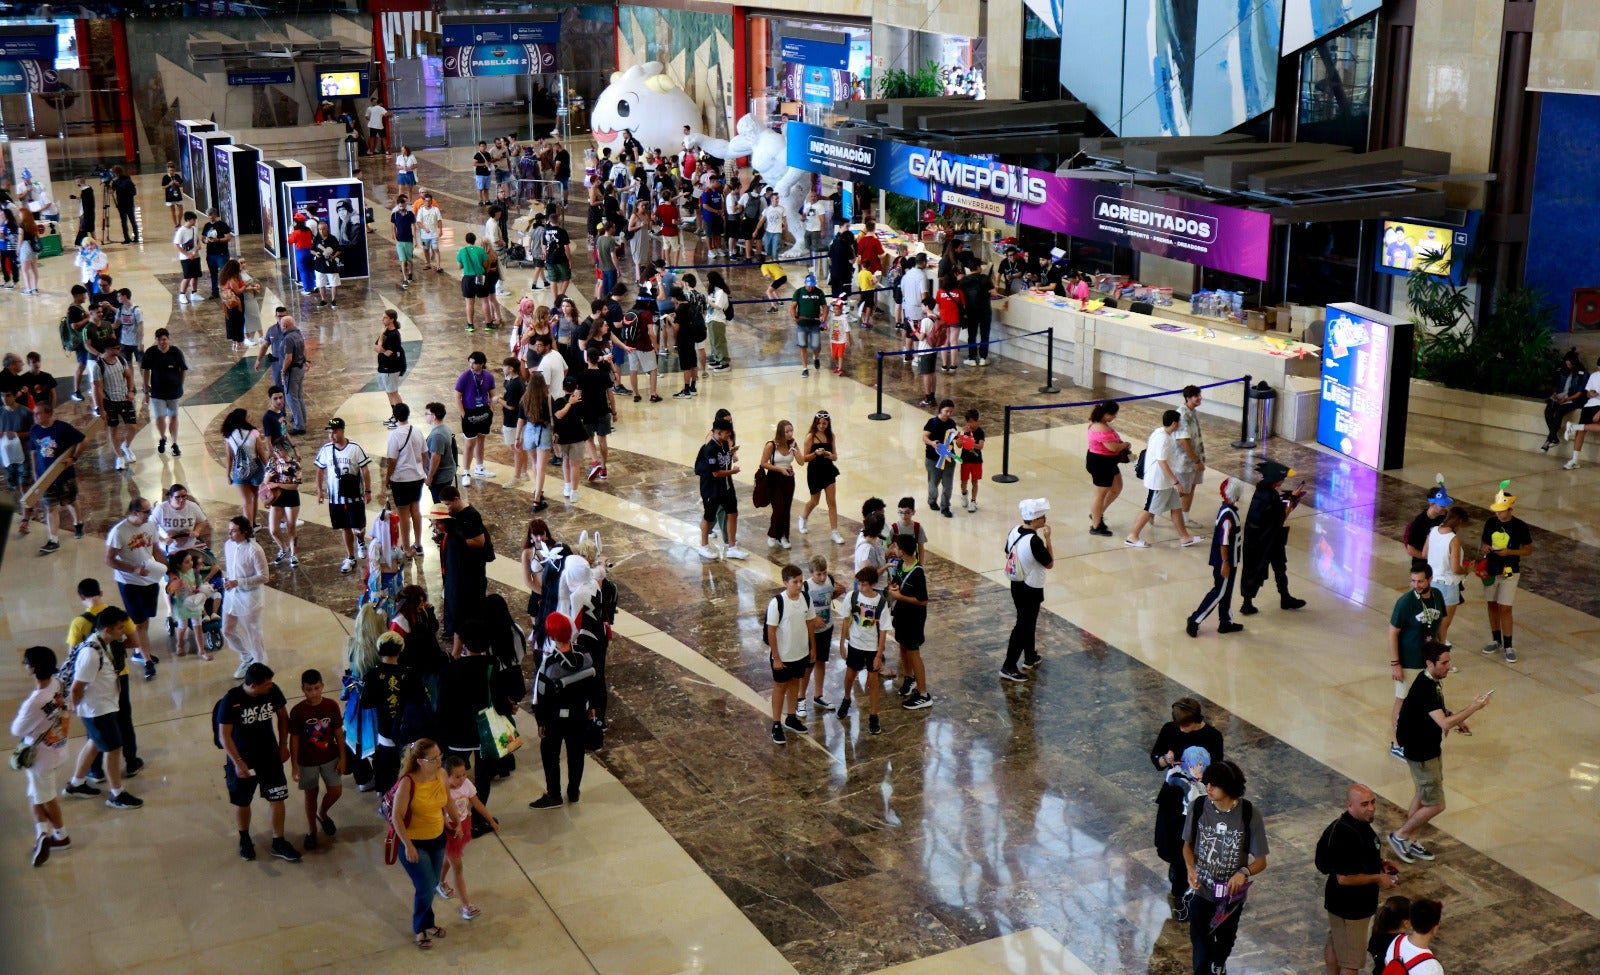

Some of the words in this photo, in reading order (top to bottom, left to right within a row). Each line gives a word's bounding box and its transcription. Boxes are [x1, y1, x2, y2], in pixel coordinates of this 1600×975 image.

[472, 58, 518, 66] PABELLÓN
[810, 141, 871, 164] INFORMACIÓN
[908, 153, 1046, 205] GAMEPOLIS
[957, 197, 1001, 213] ANIVERSARIO
[1099, 202, 1210, 238] ACREDITADOS
[163, 517, 194, 529] HOPE
